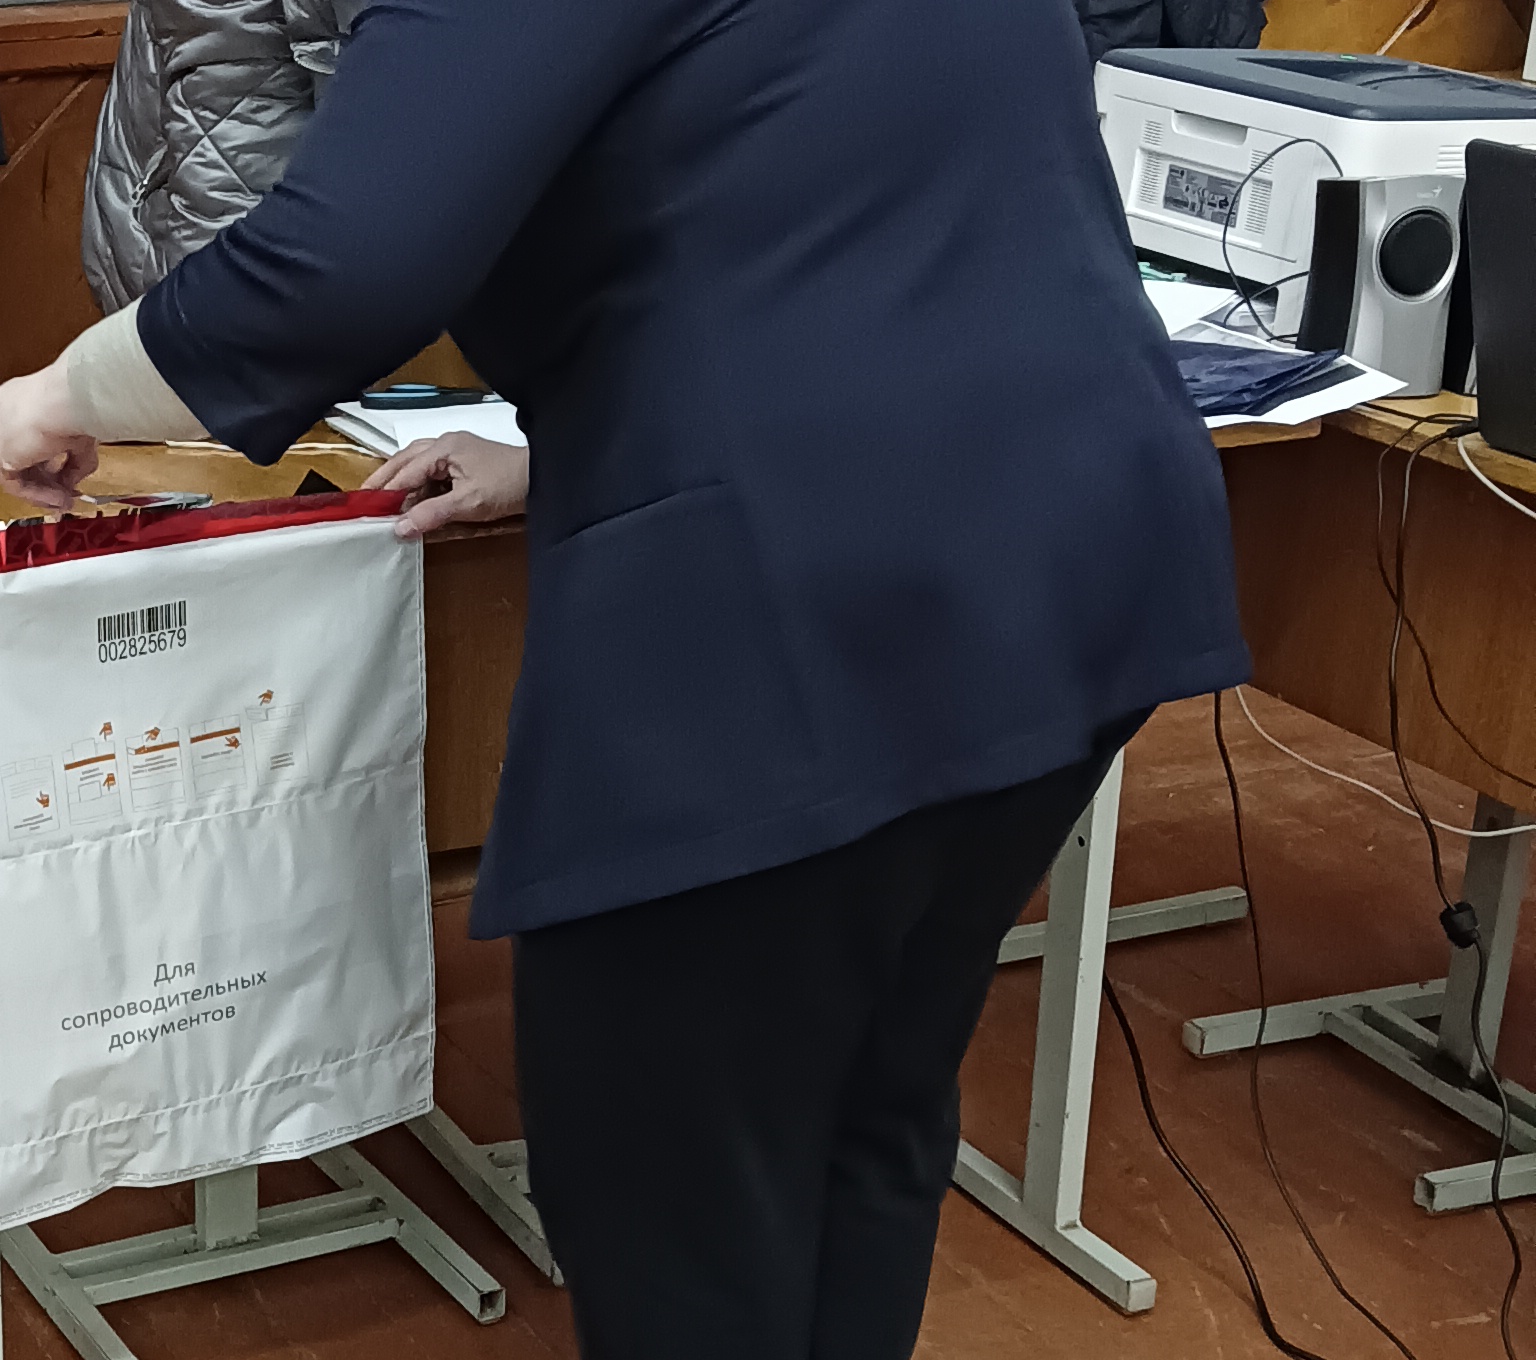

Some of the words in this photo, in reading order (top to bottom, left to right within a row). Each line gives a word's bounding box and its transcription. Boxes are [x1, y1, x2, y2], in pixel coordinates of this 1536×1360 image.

[98, 627, 188, 664] 002825679
[152, 959, 197, 985] Для
[60, 968, 268, 1031] сопроводительных
[108, 1003, 237, 1052] документов
